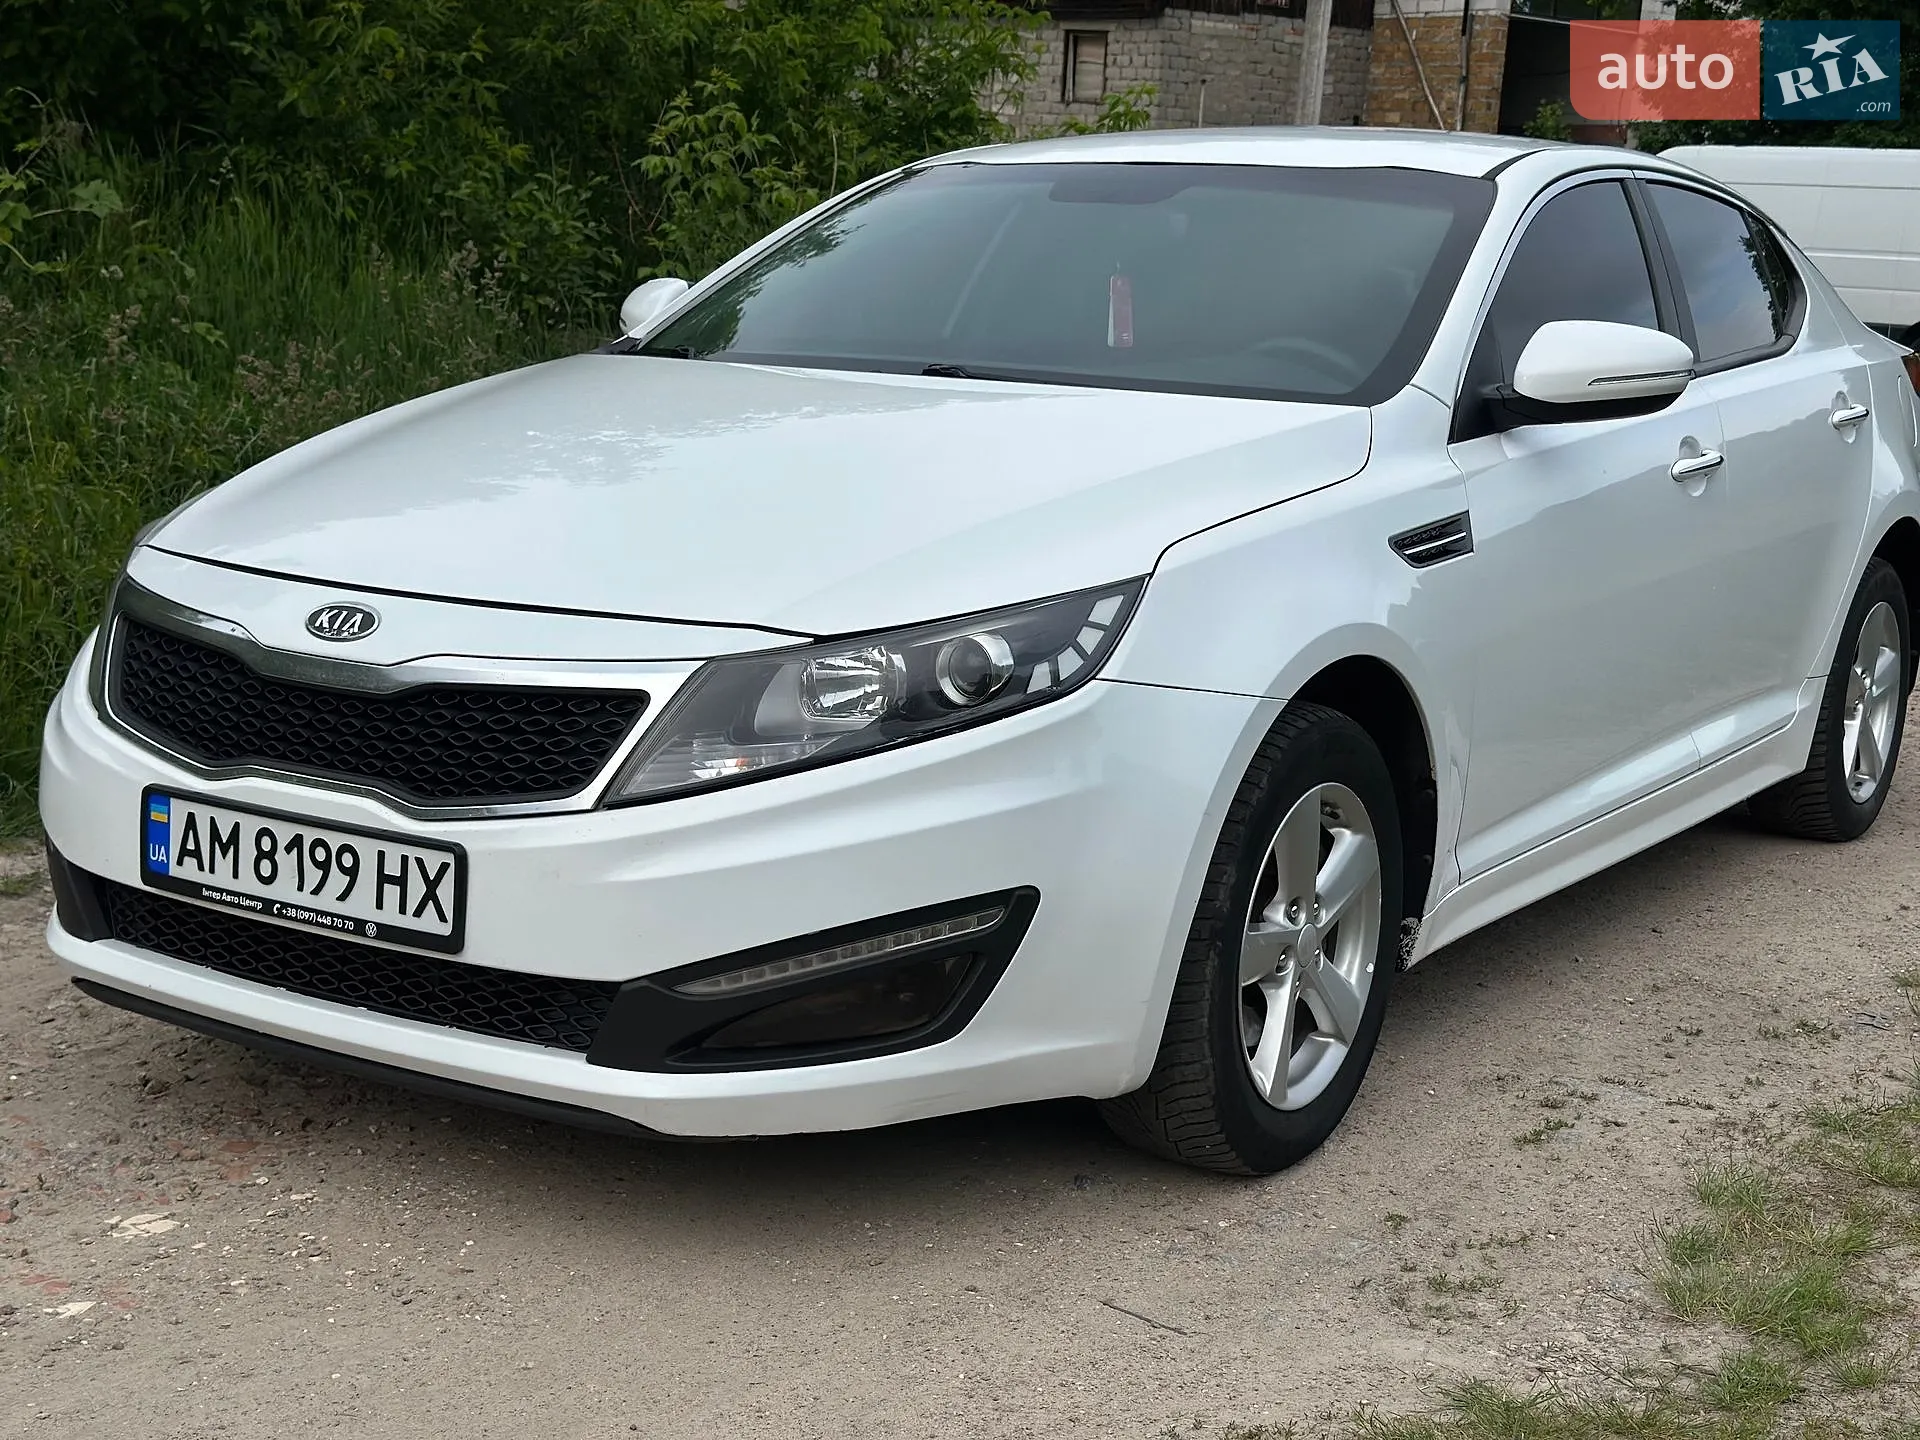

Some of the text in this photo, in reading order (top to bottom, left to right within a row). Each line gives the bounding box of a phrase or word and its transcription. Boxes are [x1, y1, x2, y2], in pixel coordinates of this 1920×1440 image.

[314, 608, 364, 633] KIA
[150, 843, 167, 863] UA
[176, 811, 451, 923] AM 8199 HX
[202, 887, 263, 910] Інтер Авто Центр
[282, 907, 354, 930] +38 (097) 448 70 70
